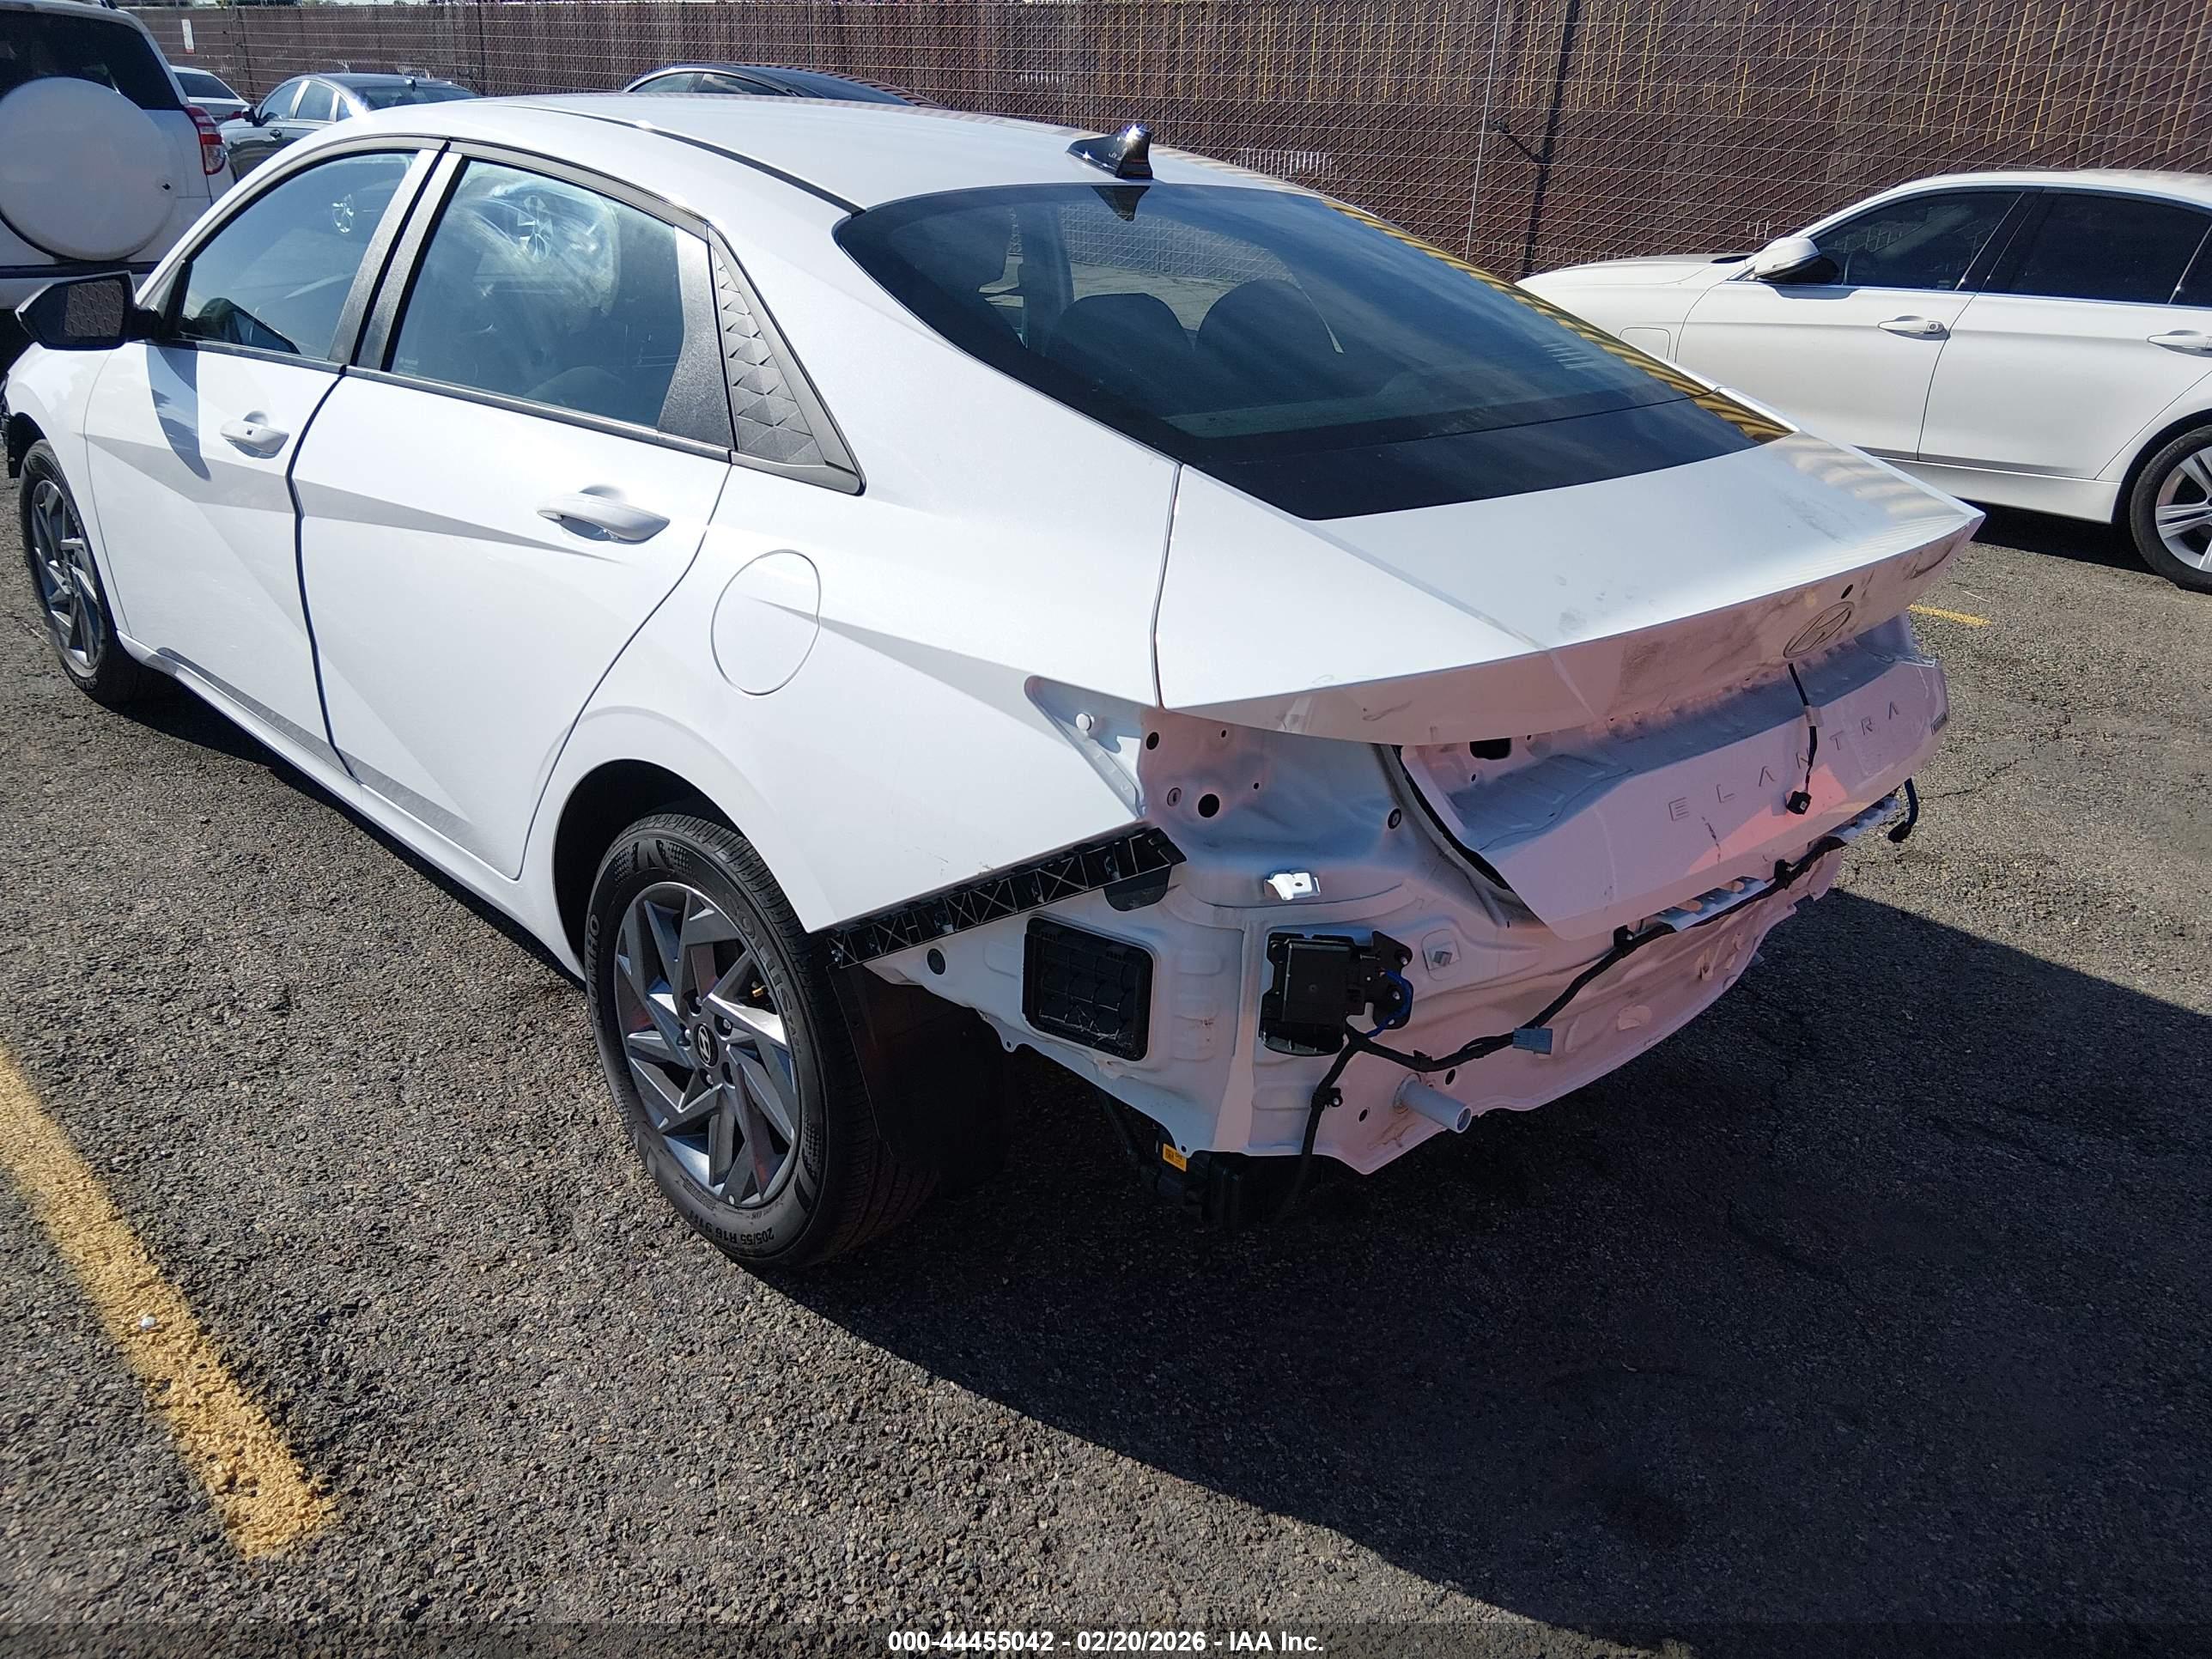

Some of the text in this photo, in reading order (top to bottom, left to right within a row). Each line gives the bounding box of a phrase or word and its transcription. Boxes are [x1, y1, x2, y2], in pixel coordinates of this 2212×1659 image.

[1668, 700, 1900, 822] ELANTRA
[722, 891, 793, 1012] SOLUS
[714, 1226, 738, 1245] R16
[738, 1226, 775, 1246] 205/55
